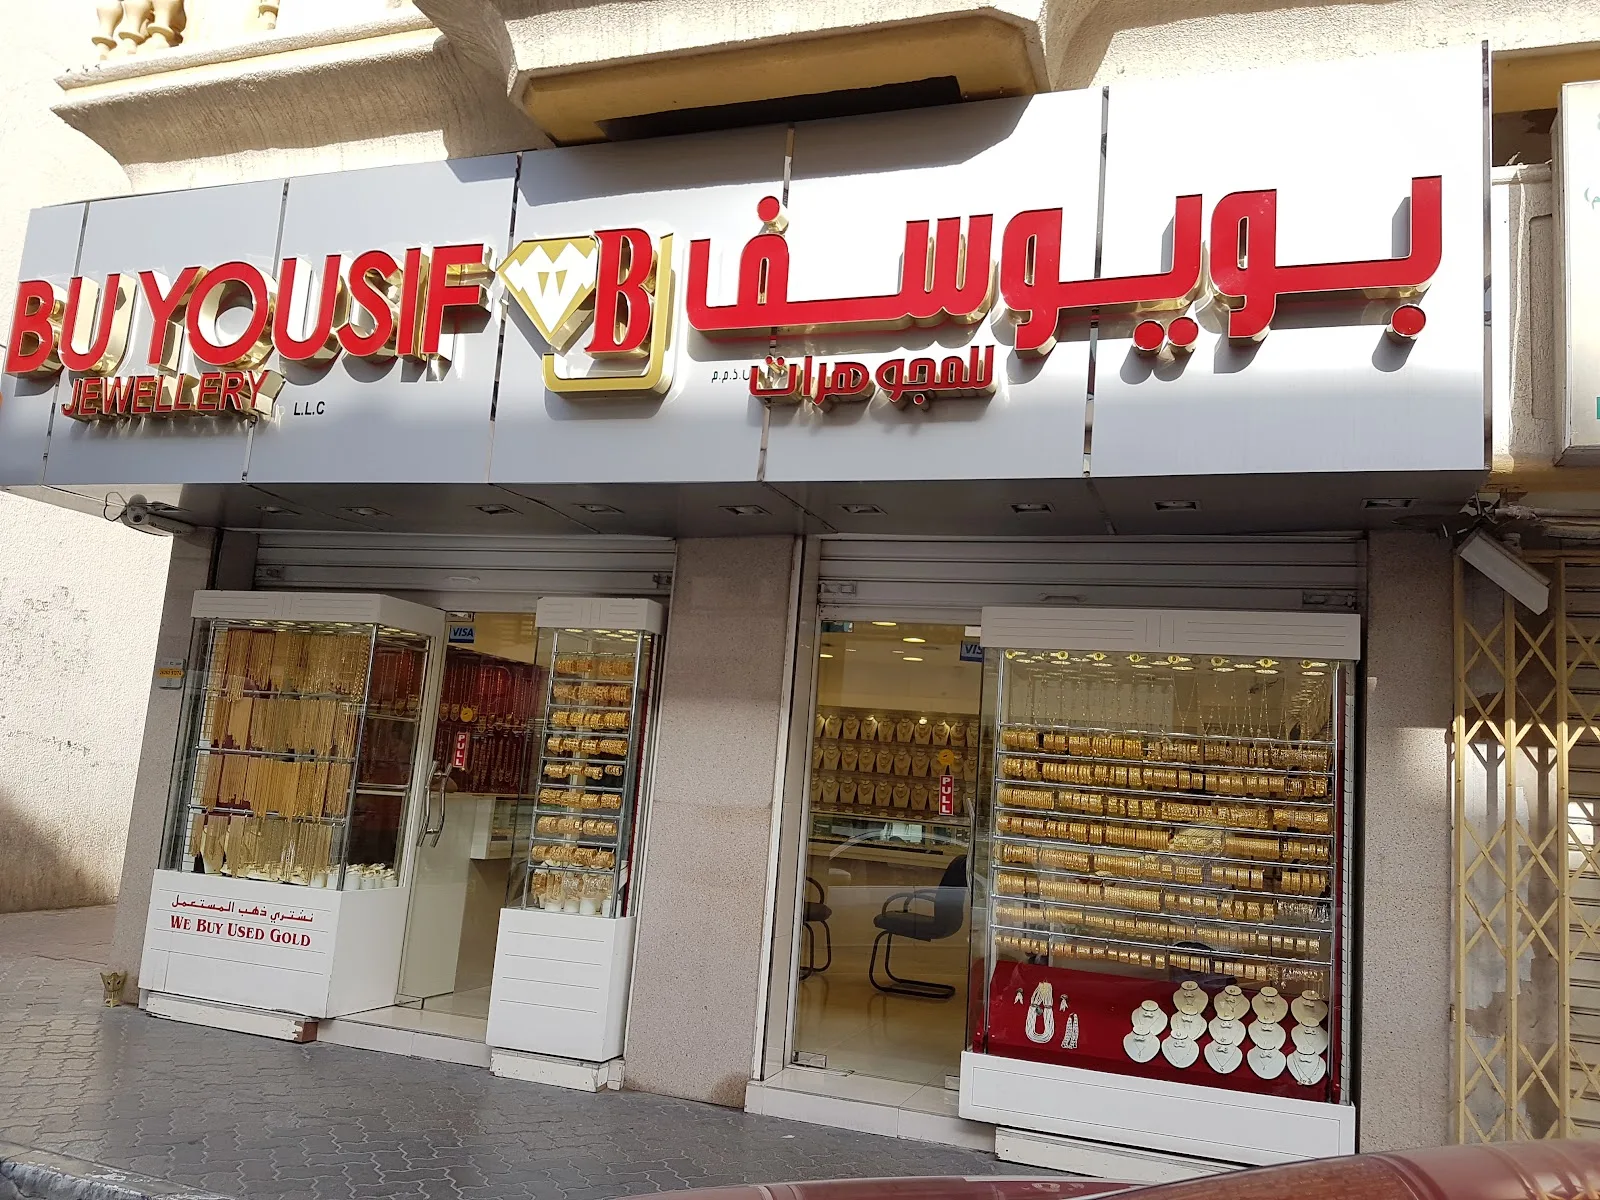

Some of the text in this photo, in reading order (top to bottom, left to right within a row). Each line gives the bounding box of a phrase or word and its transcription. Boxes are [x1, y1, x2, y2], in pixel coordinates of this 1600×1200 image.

[749, 344, 996, 406] للمجوهرات
[60, 369, 325, 416] JEWELLERY L.L.C
[452, 627, 474, 637] VISA
[455, 734, 466, 766] PULL
[941, 776, 952, 813] PULL
[171, 894, 314, 924] نشتري ذهب المستعمل
